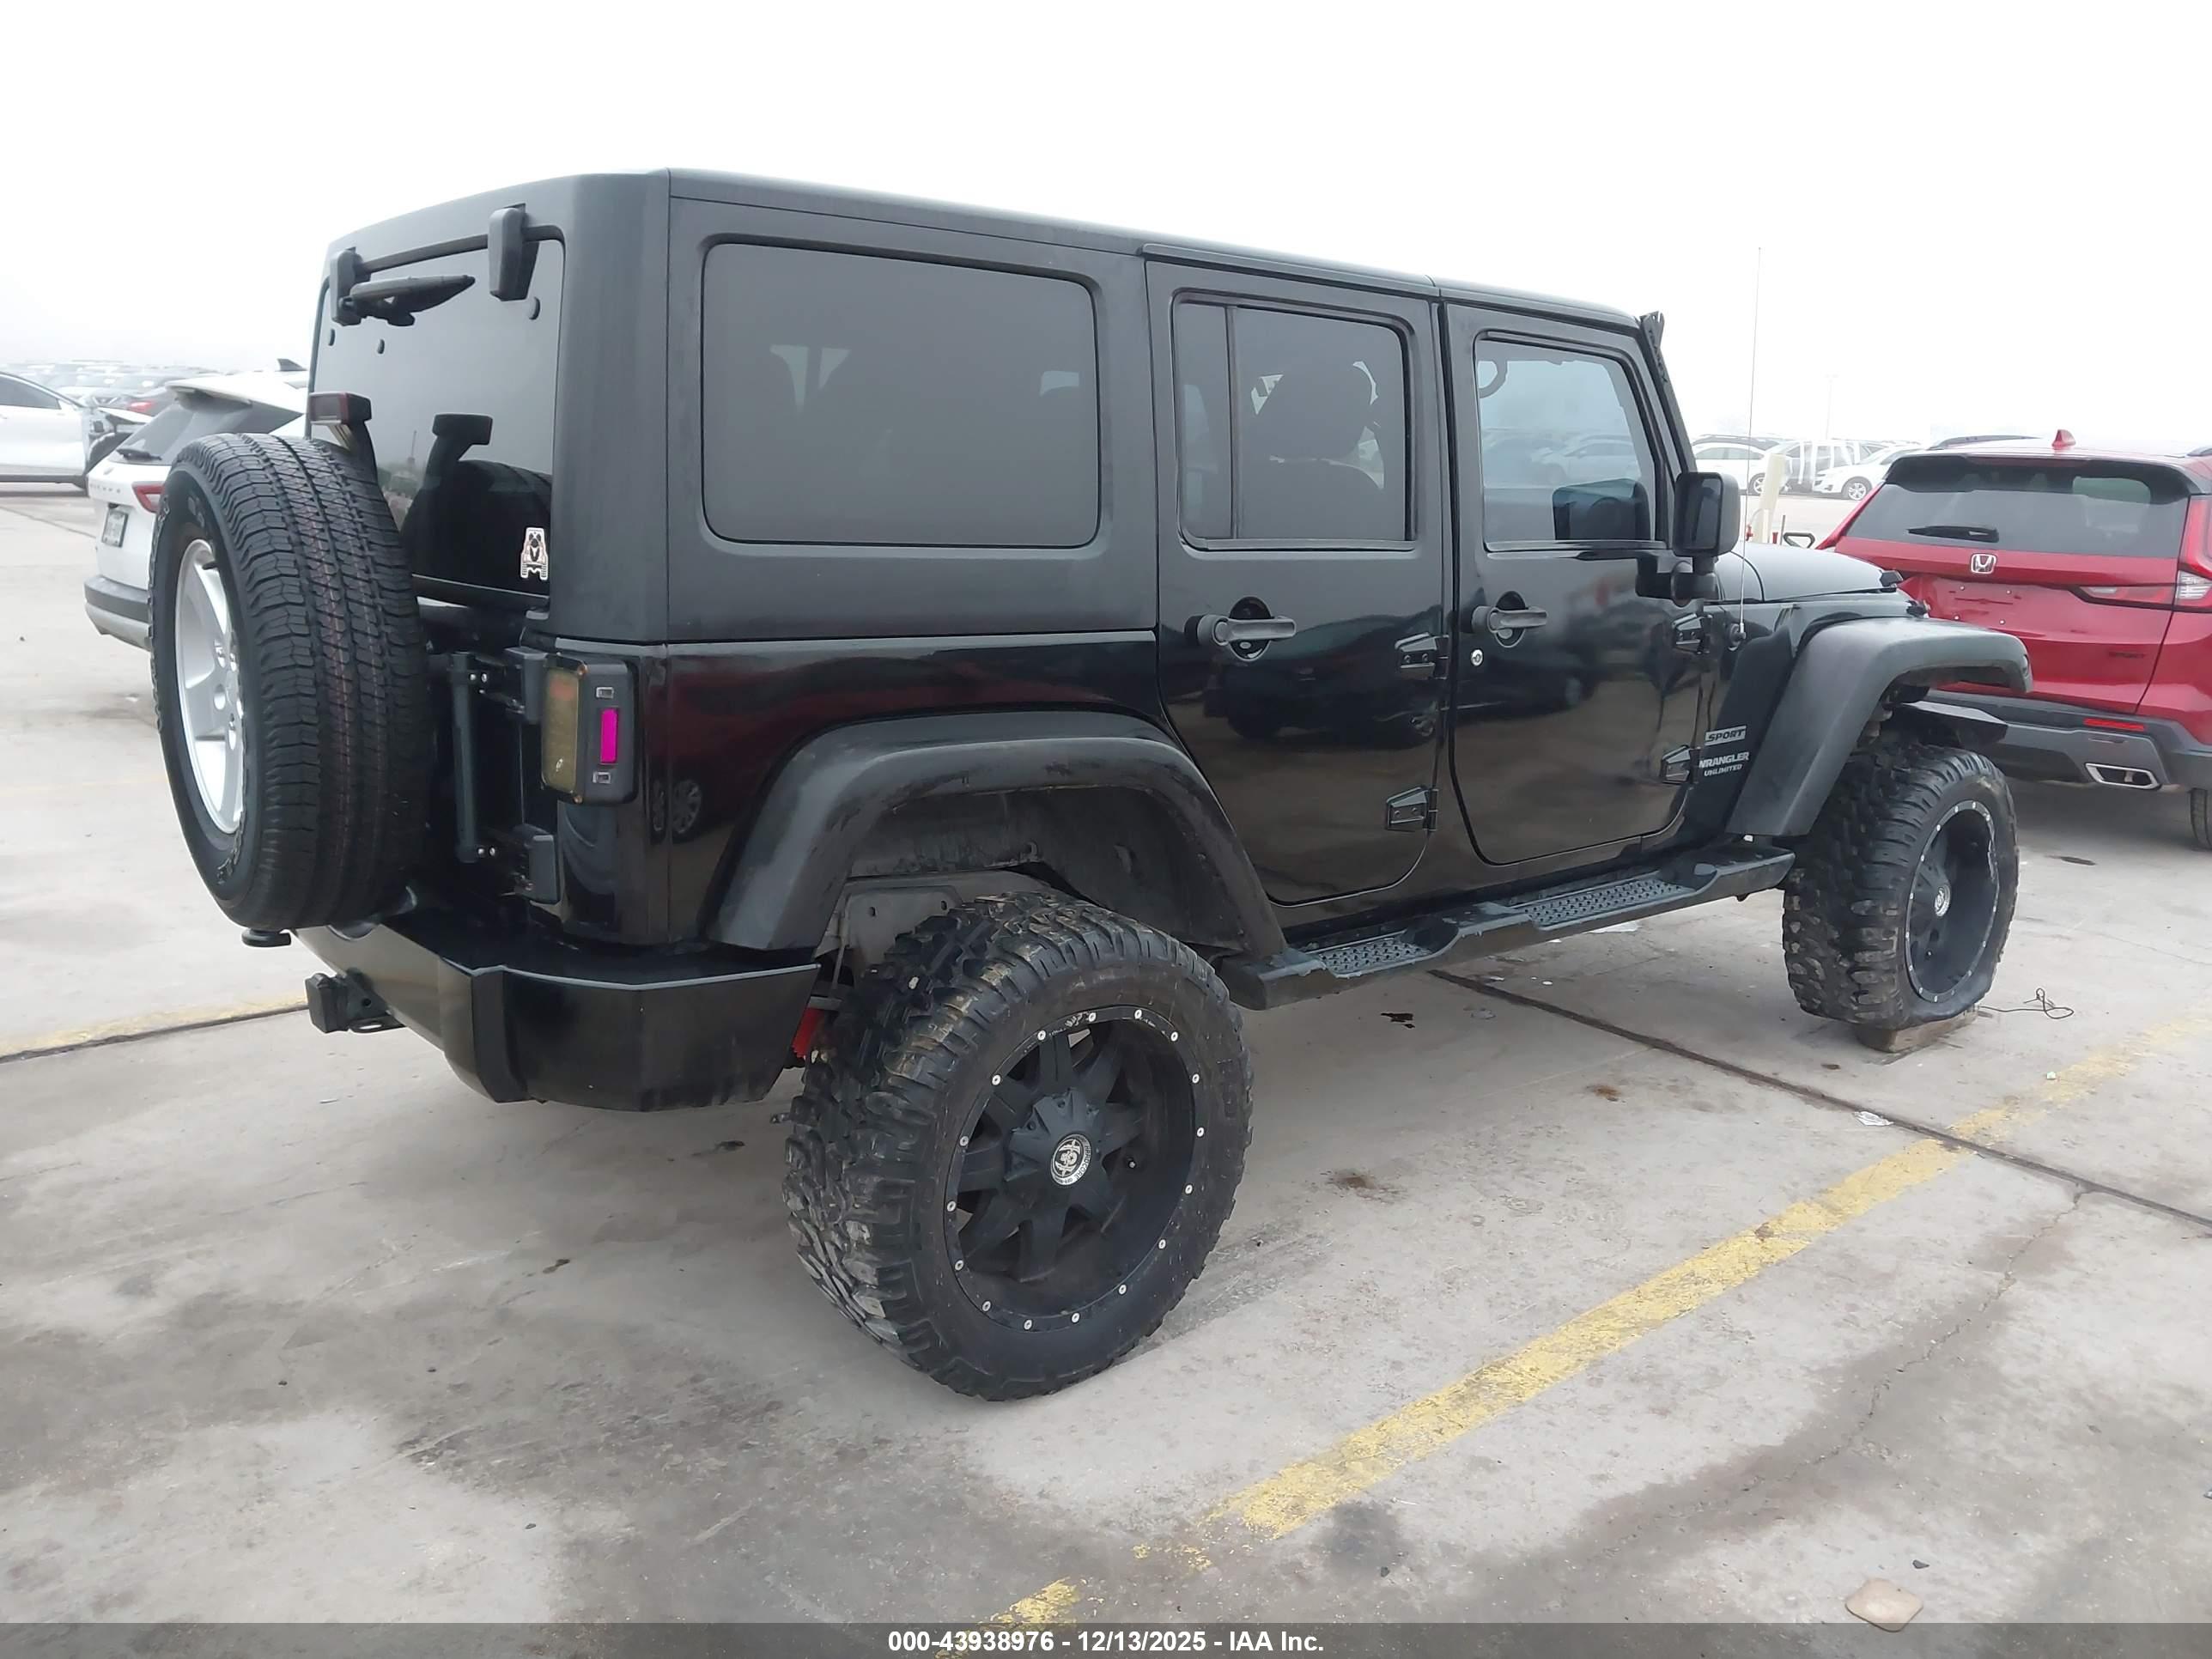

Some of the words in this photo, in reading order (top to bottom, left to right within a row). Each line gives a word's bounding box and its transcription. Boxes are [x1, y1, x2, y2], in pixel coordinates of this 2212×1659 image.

[1707, 728, 1744, 743] SPORT
[1698, 751, 1749, 769] WRANGLER
[1704, 763, 1743, 776] UNLIMITED
[1073, 1146, 1091, 1179] HARDCORE
